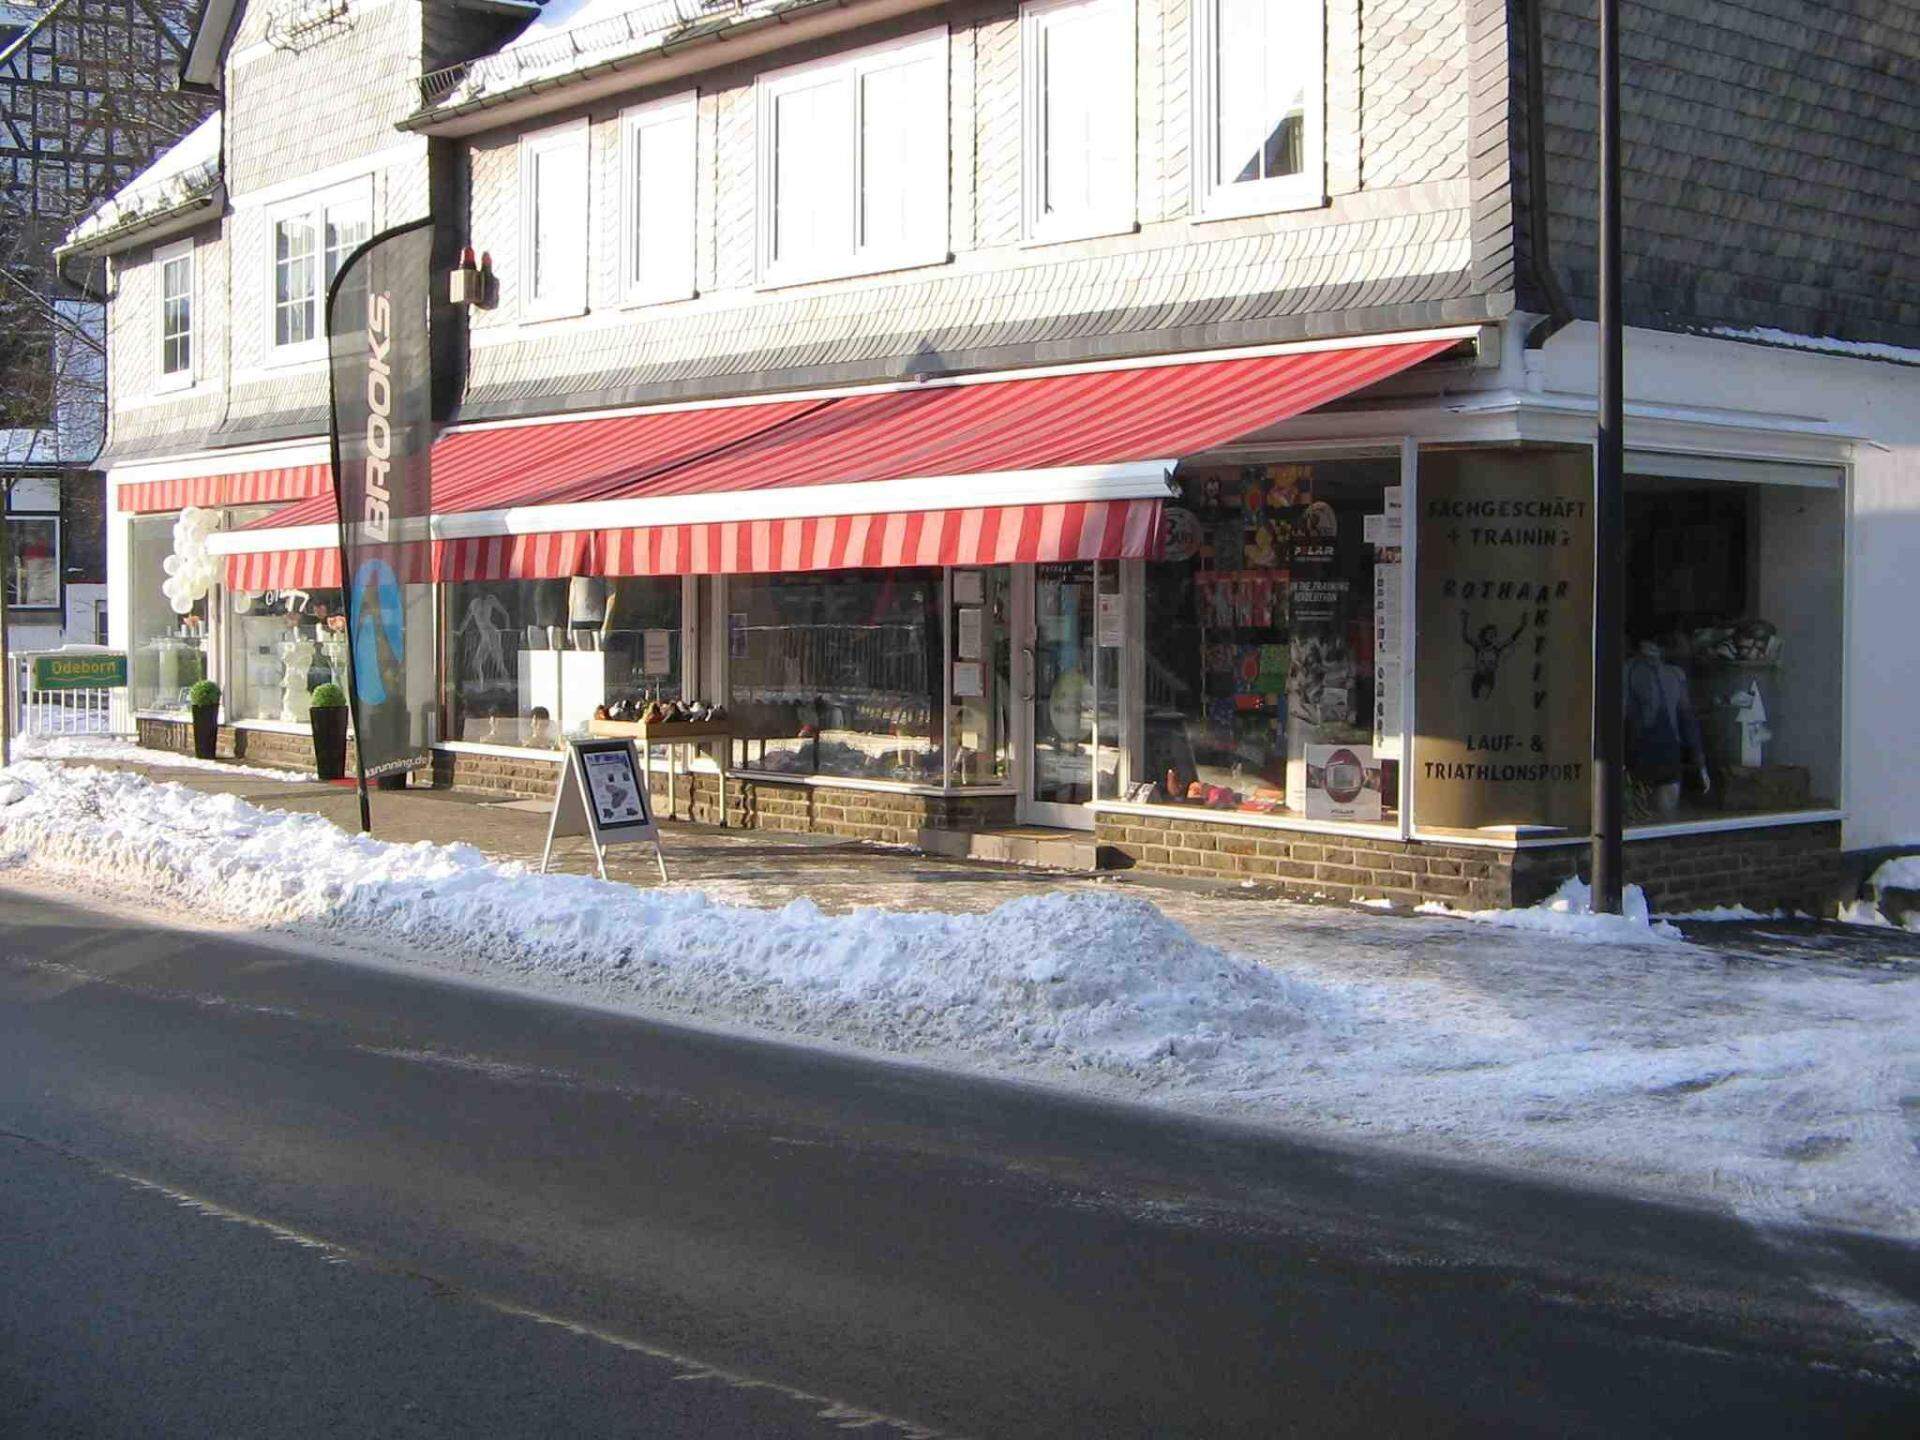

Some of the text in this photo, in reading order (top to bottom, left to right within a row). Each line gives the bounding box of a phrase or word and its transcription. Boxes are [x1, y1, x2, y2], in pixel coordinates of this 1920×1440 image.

[364, 293, 392, 543] BROOKS
[1427, 496, 1586, 518] FACHGESCHÄFT
[1443, 580, 1569, 603] ROTHAAR
[52, 660, 116, 674] Odeborn
[1467, 734, 1544, 752] LAUF- &
[1425, 762, 1583, 782] TRIATHLONSPORT
